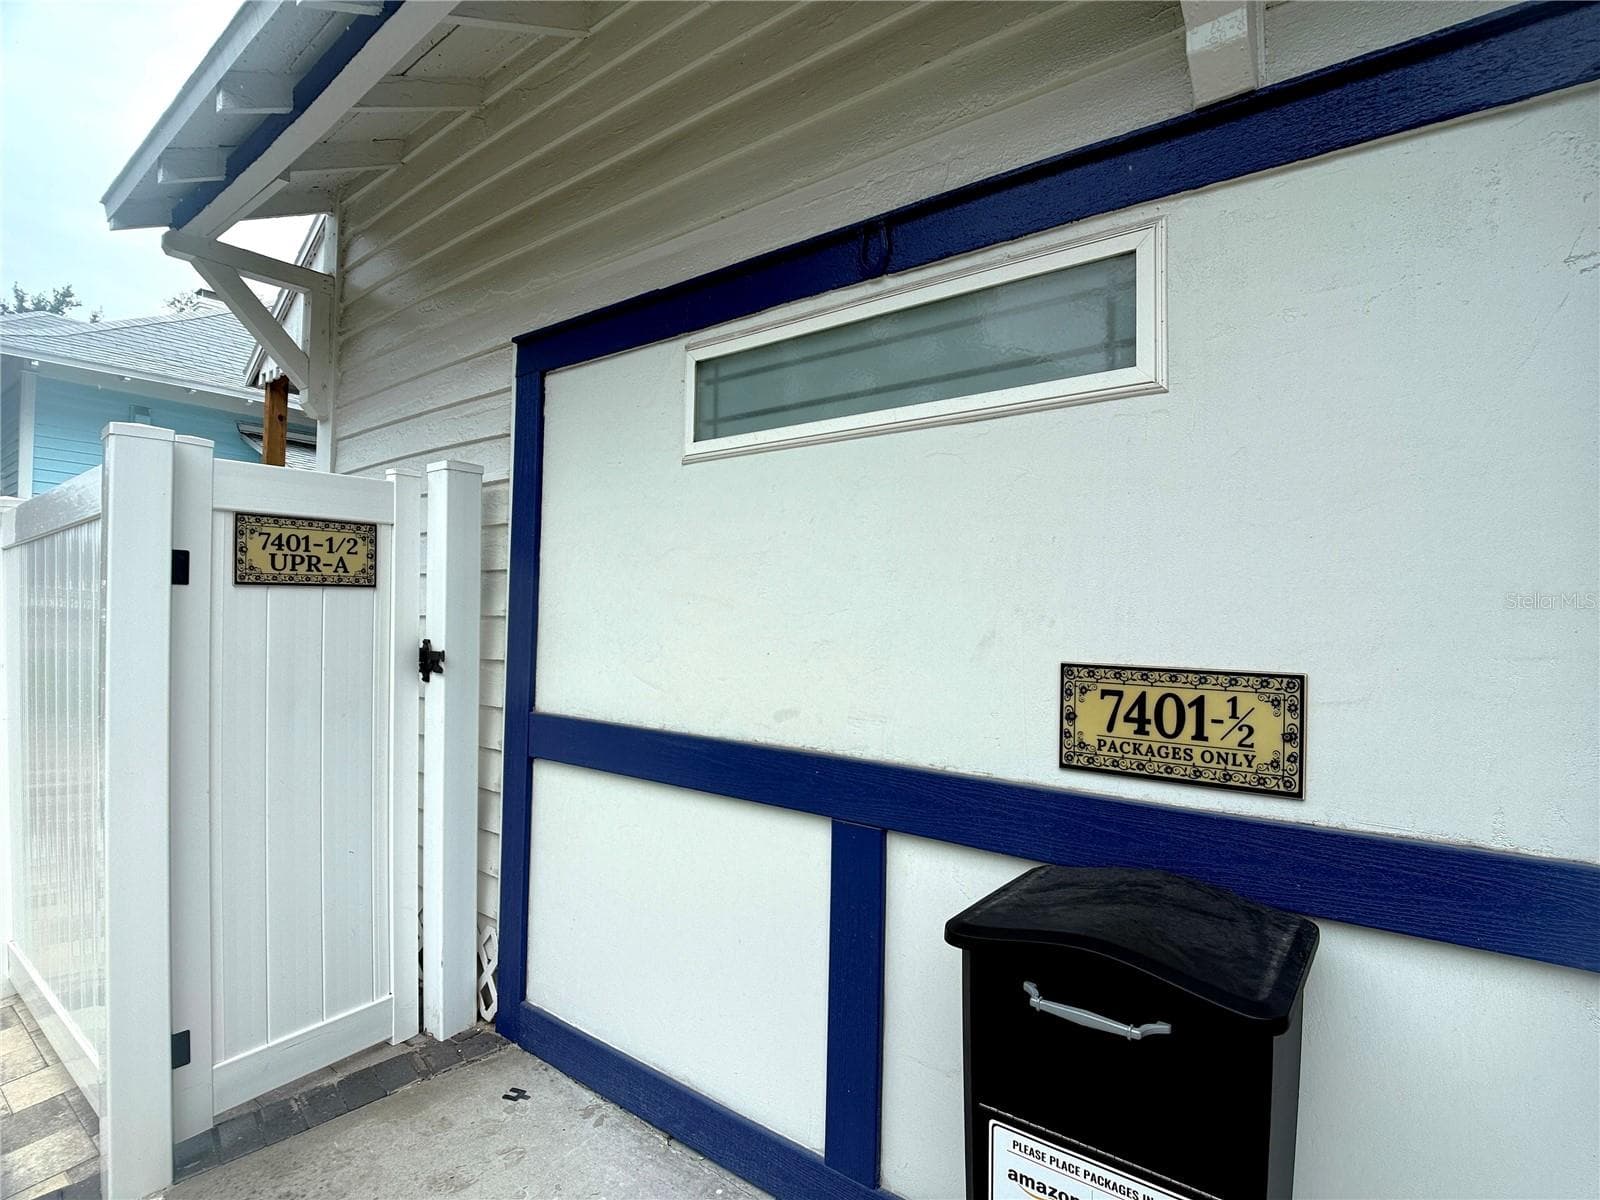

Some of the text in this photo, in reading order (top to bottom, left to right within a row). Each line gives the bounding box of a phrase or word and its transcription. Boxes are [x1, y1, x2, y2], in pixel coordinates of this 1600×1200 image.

[258, 532, 358, 555] 7401-1/2
[269, 553, 350, 574] UPR-A
[1096, 738, 1257, 769] PACKAGES ONLY
[1012, 1139, 1047, 1163] PLEASE
[1049, 1155, 1082, 1178] PLACE
[1083, 1169, 1140, 1200] PACKAGES
